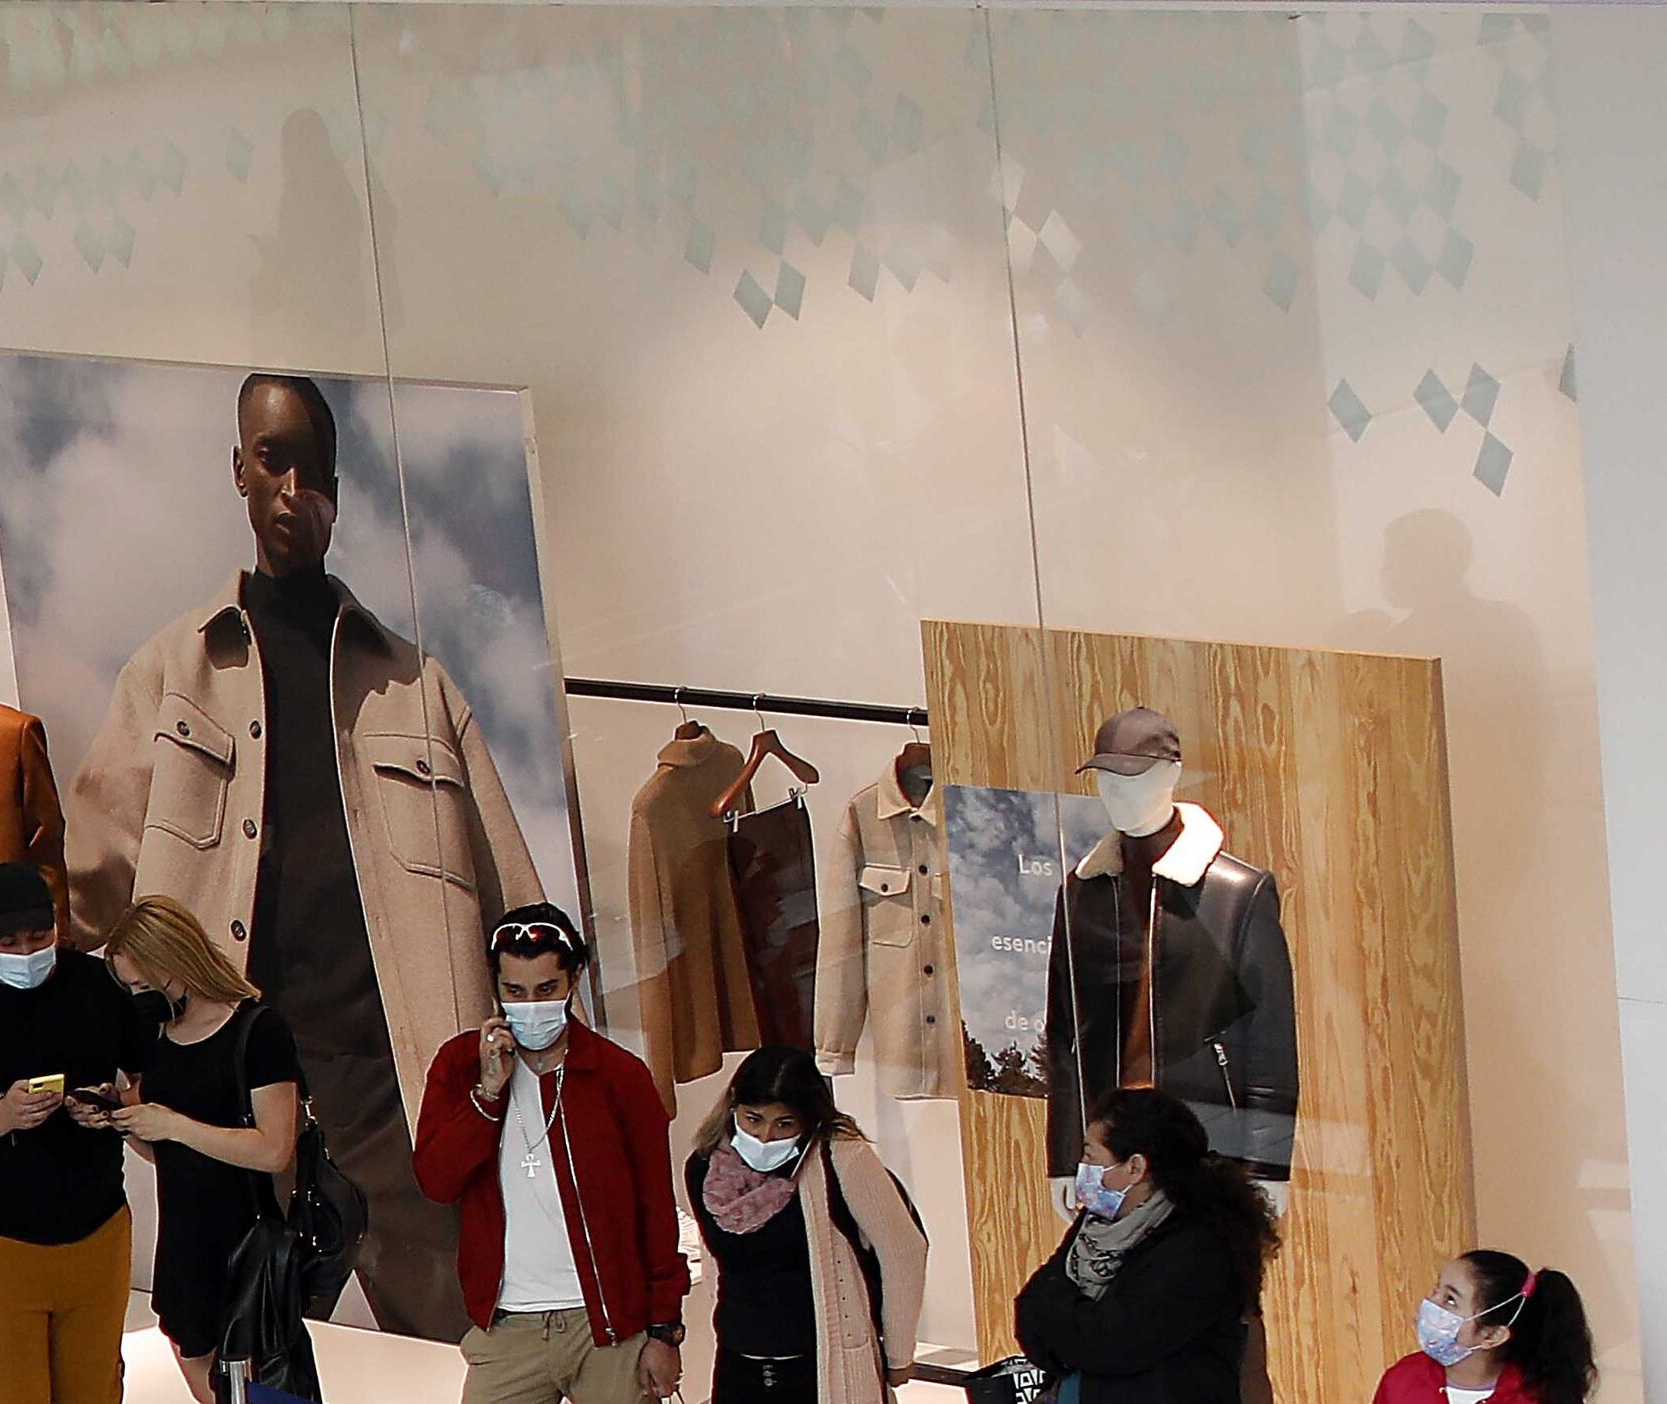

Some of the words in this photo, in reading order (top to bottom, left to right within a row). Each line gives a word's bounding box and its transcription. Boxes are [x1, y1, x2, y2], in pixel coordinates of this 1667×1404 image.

[1019, 854, 1052, 876] Los
[992, 935, 1052, 954] esenci
[1005, 1010, 1028, 1031] de
